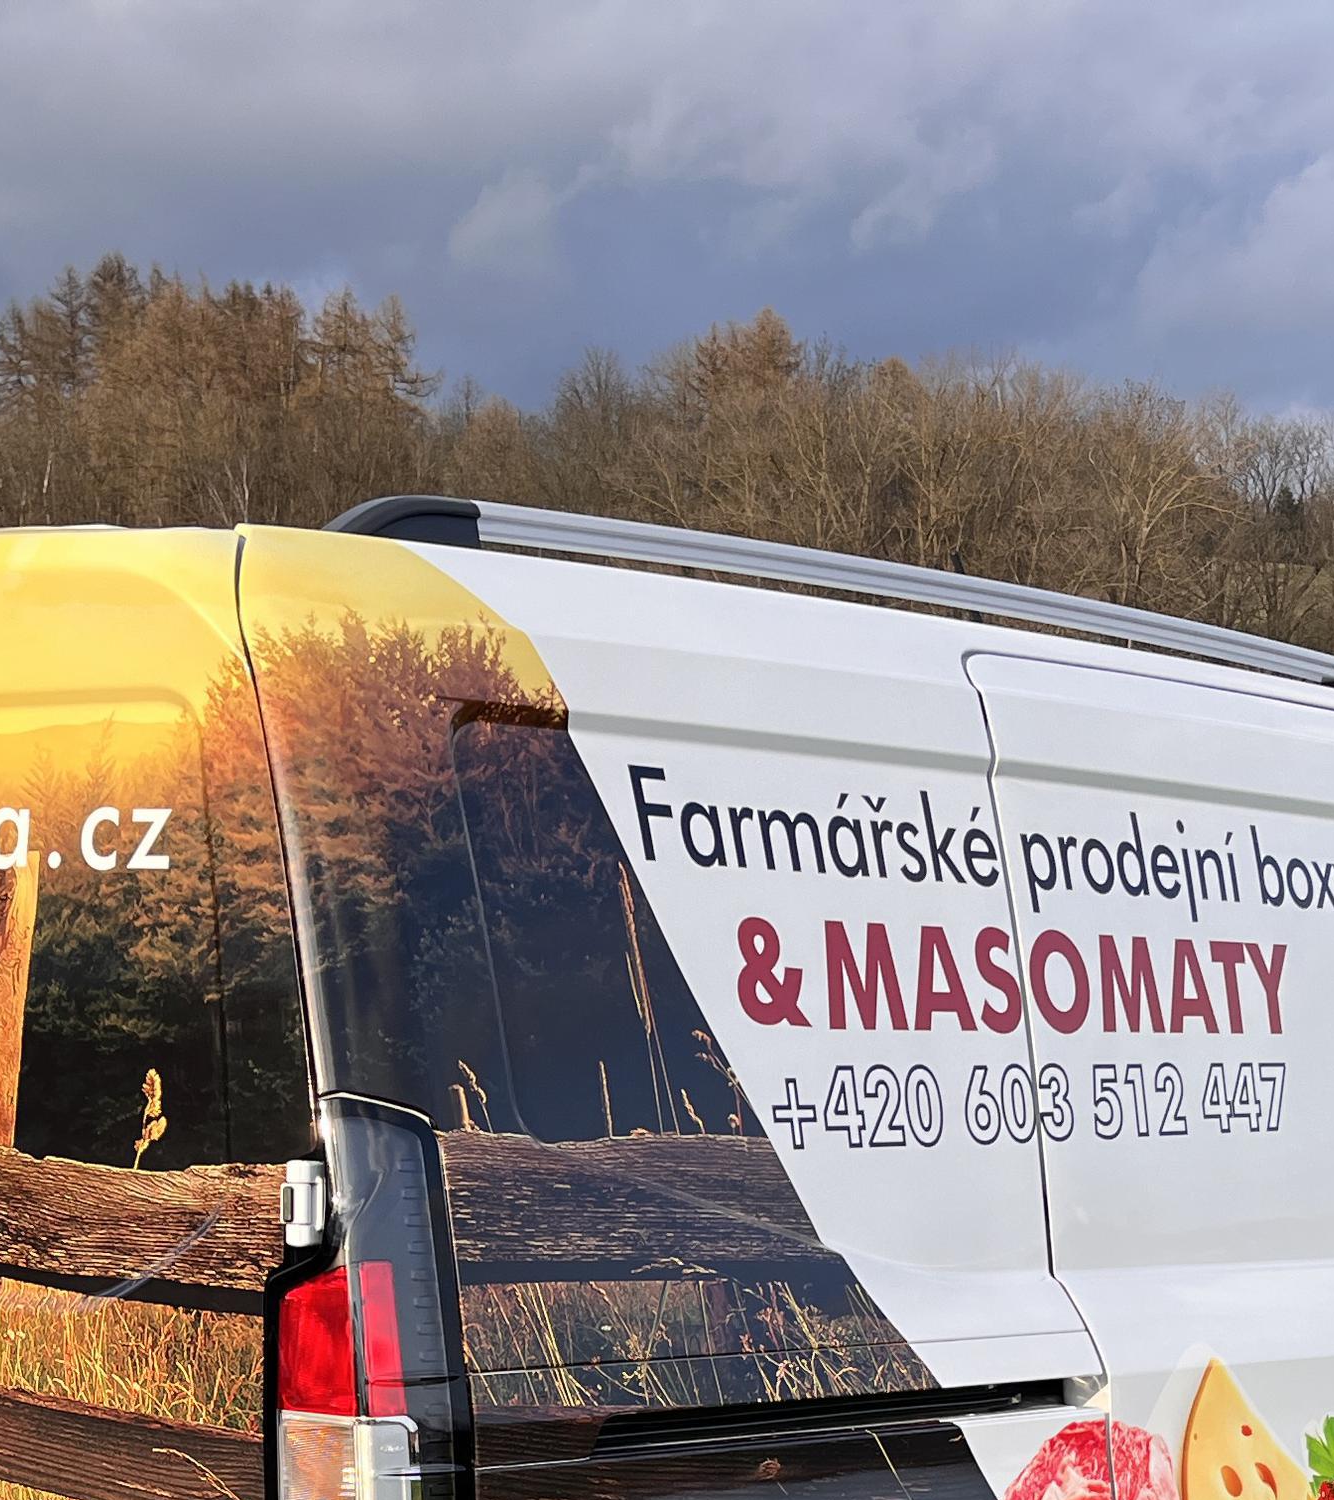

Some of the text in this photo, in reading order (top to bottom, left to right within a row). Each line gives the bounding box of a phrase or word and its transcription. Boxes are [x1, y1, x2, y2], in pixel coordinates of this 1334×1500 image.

[627, 764, 1001, 888] Farmářské
[1021, 812, 1241, 922] prodejní
[773, 1062, 1287, 1150] +420 603 512 447
